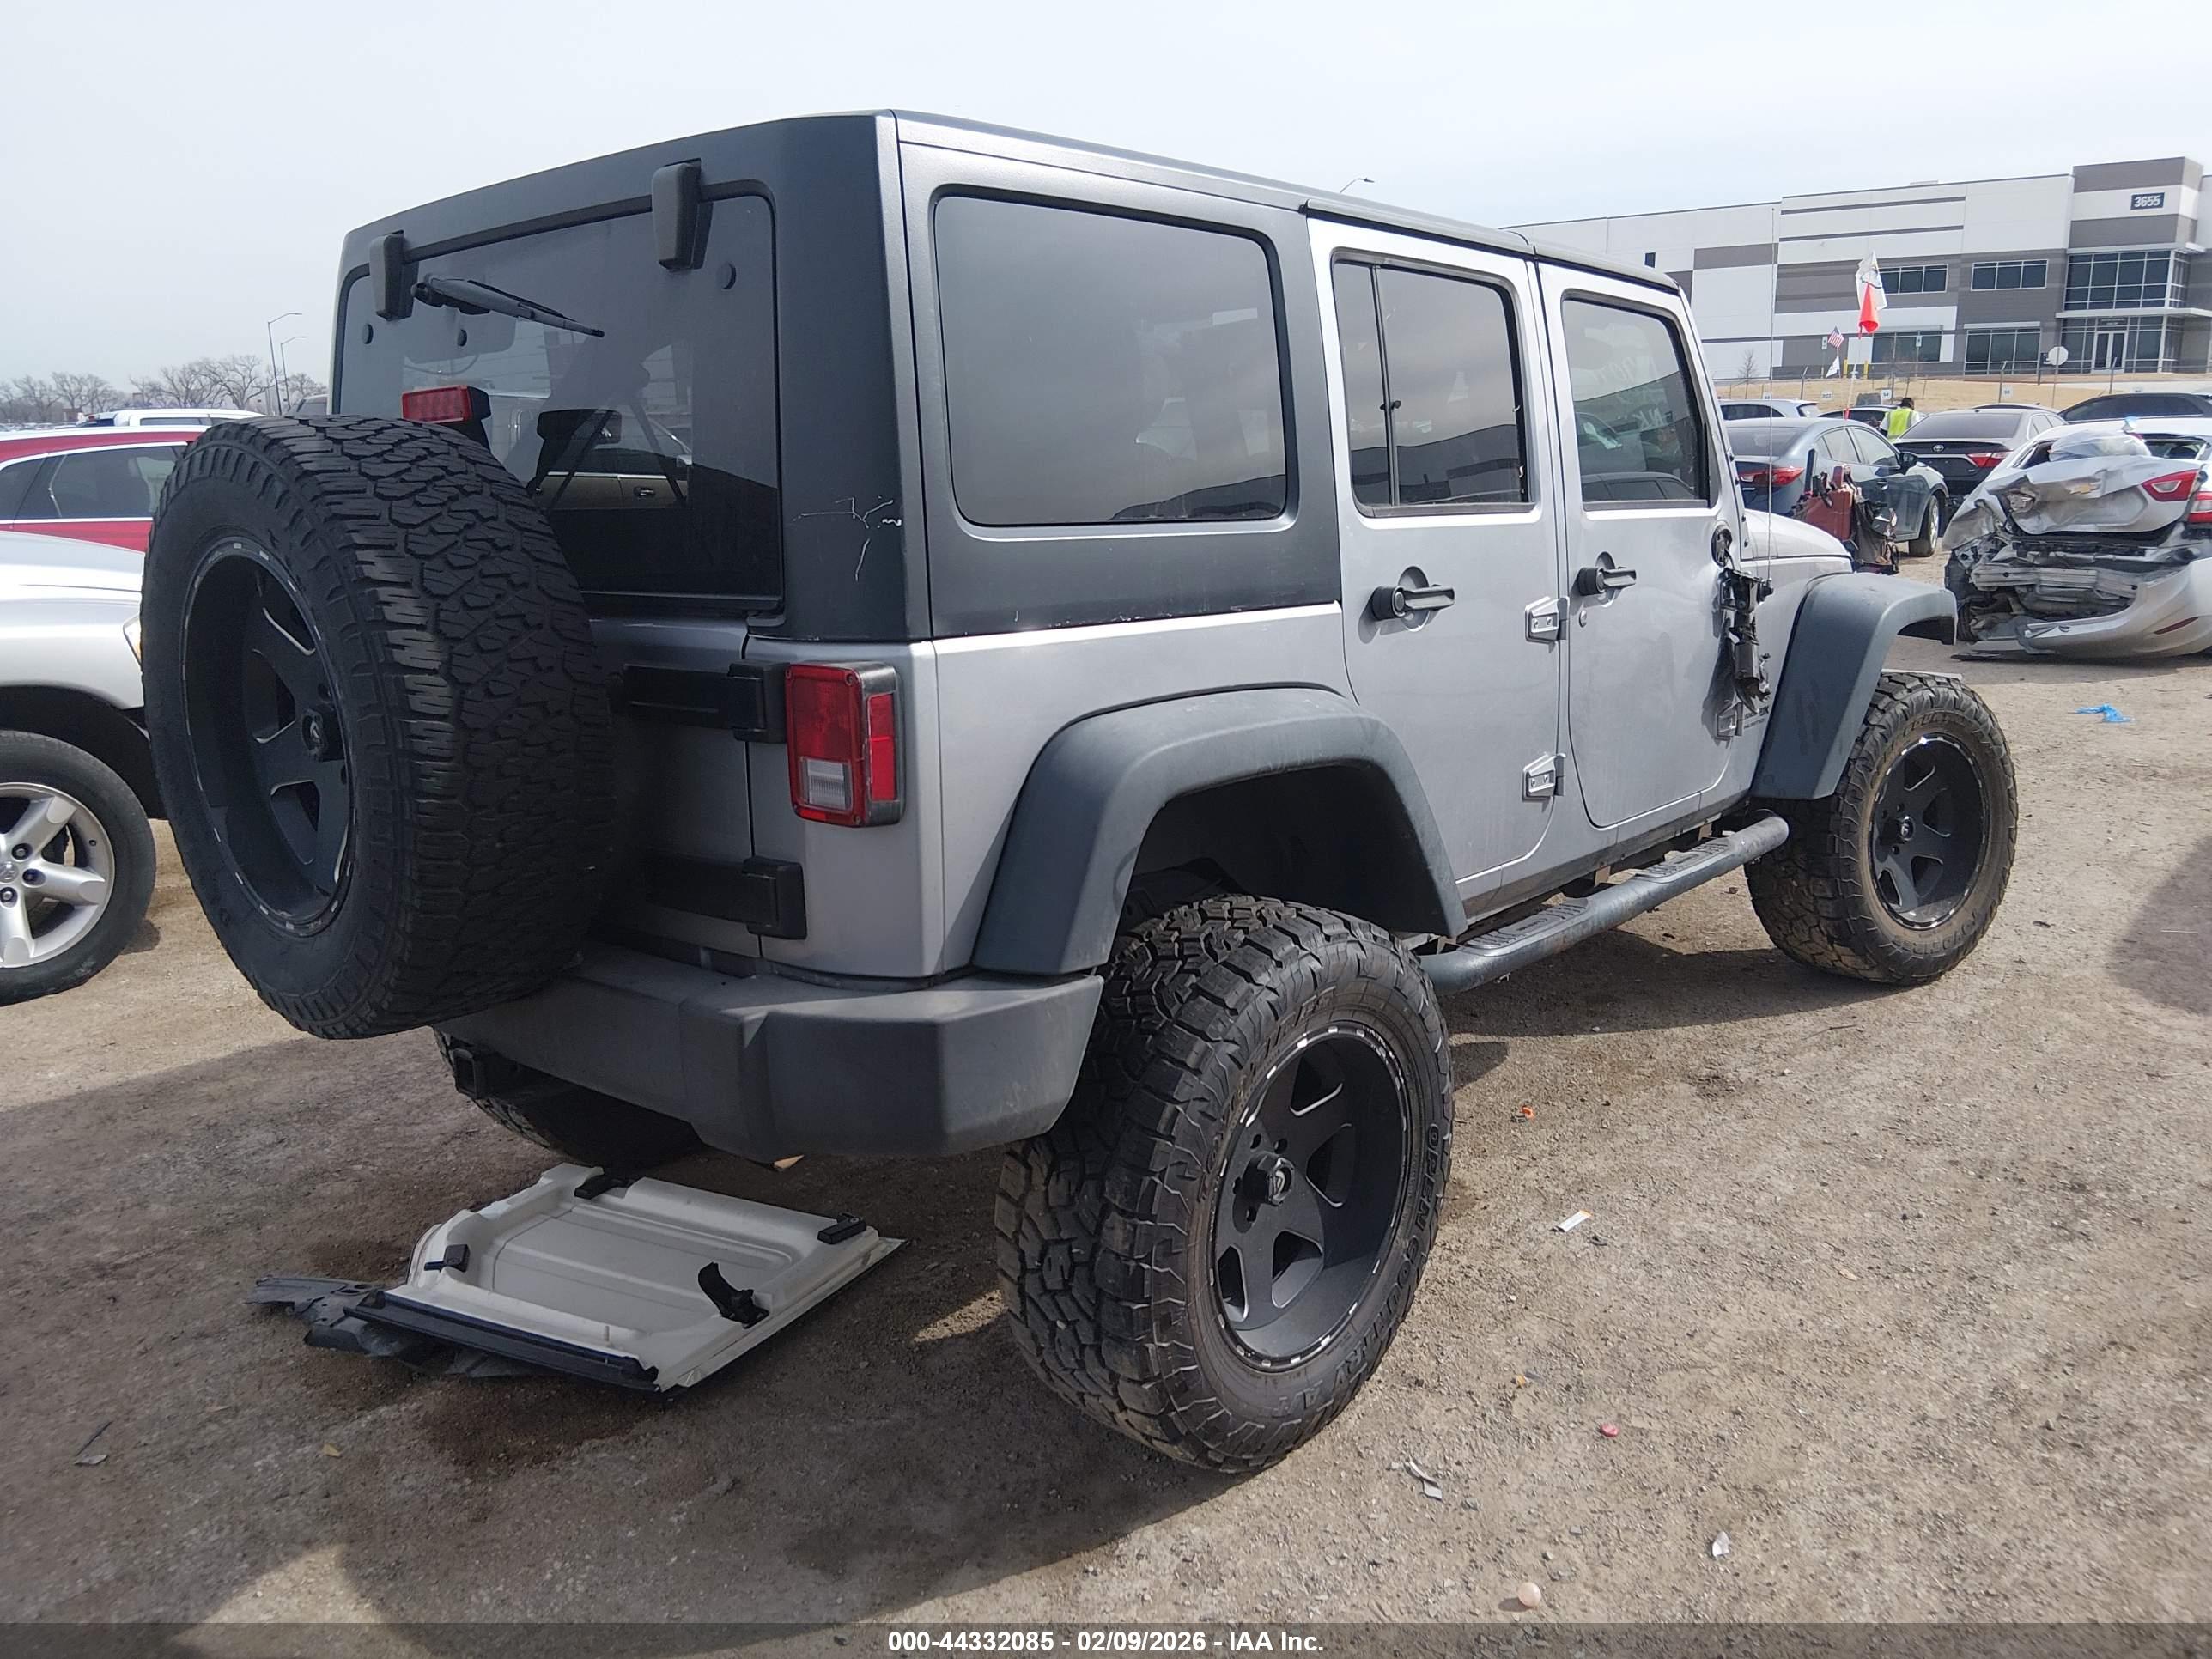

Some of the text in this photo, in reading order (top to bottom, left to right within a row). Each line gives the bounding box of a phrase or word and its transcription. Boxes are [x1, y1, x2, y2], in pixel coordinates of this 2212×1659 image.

[2134, 195, 2160, 208] 3655
[1416, 1123, 1440, 1232] OPEN
[1333, 1235, 1419, 1394] COUNTRY
